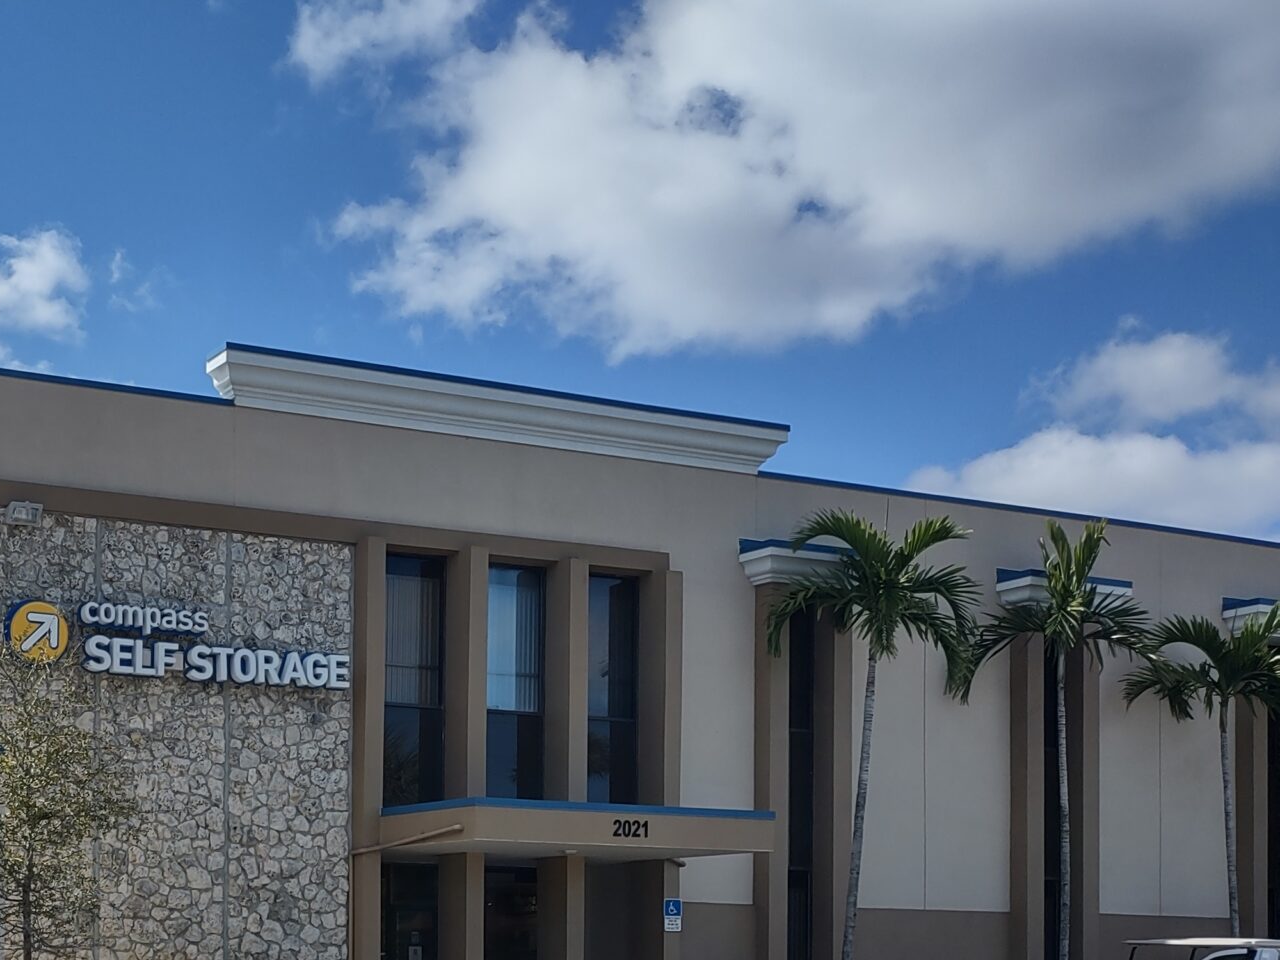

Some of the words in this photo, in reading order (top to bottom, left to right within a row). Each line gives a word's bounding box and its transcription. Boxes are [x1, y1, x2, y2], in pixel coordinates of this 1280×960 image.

[79, 601, 209, 635] compass
[82, 634, 180, 677] SELF
[185, 645, 350, 689] STORAGE
[612, 819, 649, 838] 2021
